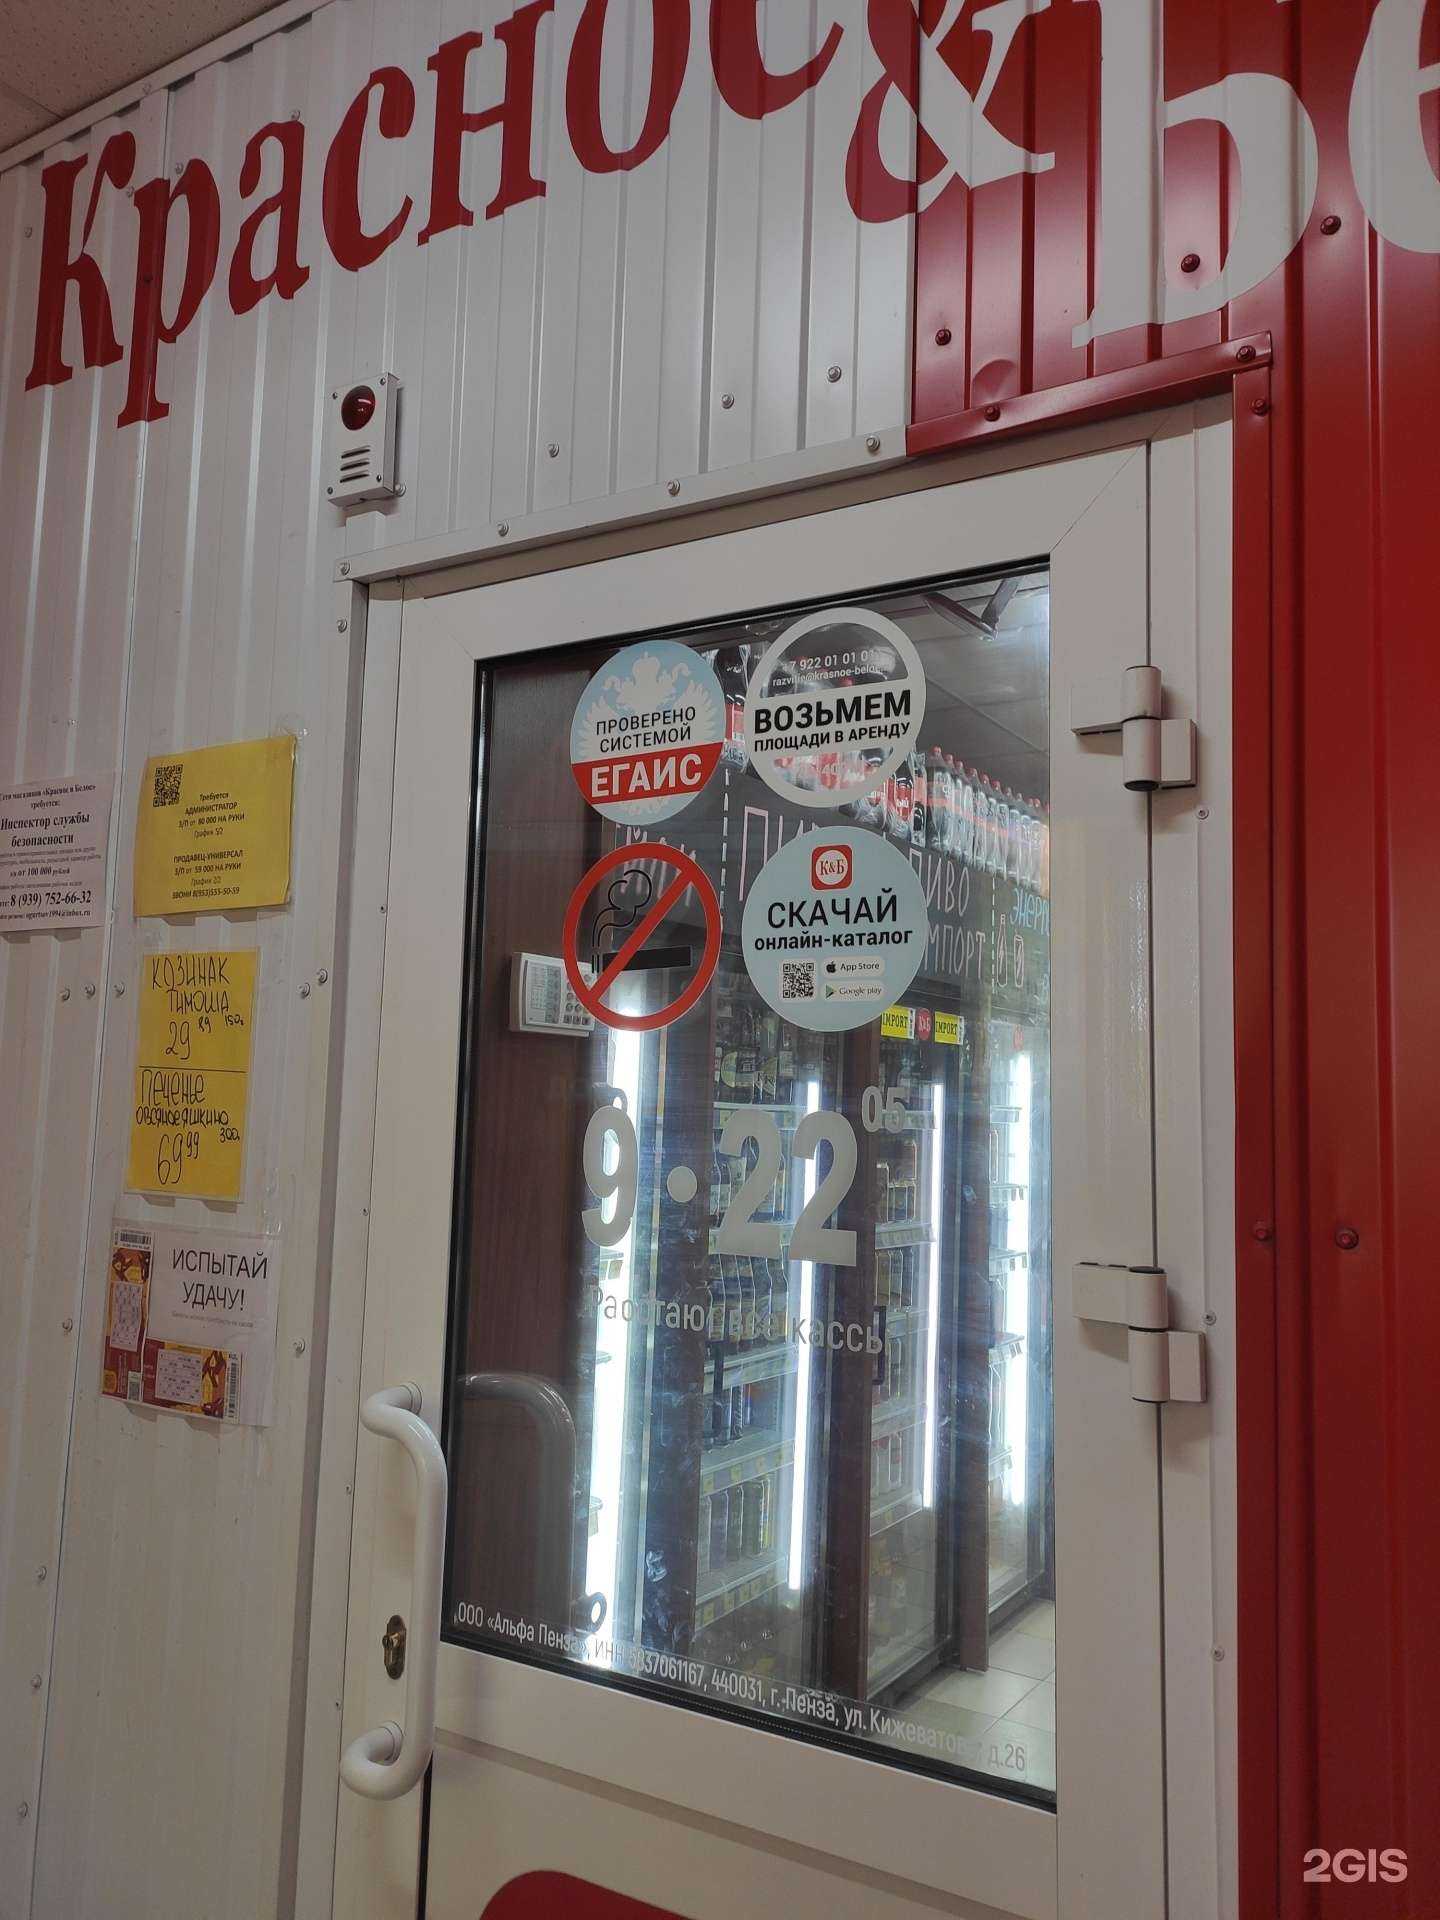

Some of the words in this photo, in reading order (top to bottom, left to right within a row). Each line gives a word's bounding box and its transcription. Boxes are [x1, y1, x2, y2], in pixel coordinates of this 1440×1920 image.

[799, 657, 821, 671] 922
[824, 654, 838, 667] 01
[842, 652, 856, 664] 01
[596, 706, 696, 736] ПРОВЕРЕНО
[754, 689, 911, 734] ВОЗЬМЕМ
[600, 722, 691, 753] СИСТЕМОЙ
[754, 731, 830, 752] ПЛОЩАДИ
[835, 731, 844, 743] В
[848, 722, 910, 742] АРЕНДУ
[591, 753, 702, 798] ЕГАИС
[200, 792, 229, 801] Требуется
[185, 801, 238, 816] АДМИНИСТРАТОР
[217, 815, 227, 823] НА
[228, 813, 245, 823] РУКИ
[1, 816, 50, 830] Инспектор
[53, 812, 90, 829] службы
[11, 834, 74, 847] безопасности
[174, 850, 243, 863] ПРОДАВЕЦ-УНИВЕРСАЛ
[214, 864, 224, 872] НА
[225, 863, 242, 871] РУКИ
[820, 859, 845, 876] К&Б
[27, 867, 39, 876] 100
[40, 866, 52, 875] 000
[10, 894, 17, 907] 8
[18, 893, 42, 909] (939)
[45, 890, 92, 905] 752-66-32
[768, 888, 898, 929] СКАЧАЙ
[754, 930, 913, 951] онлайн-каталог
[924, 922, 986, 981] МПОРТ
[840, 963, 857, 972] App
[858, 961, 880, 970] Store
[839, 986, 866, 996] Google
[867, 985, 882, 995] play
[882, 1012, 909, 1029] IMPORT
[935, 1020, 958, 1035] IMPORT
[165, 1020, 191, 1060] 29
[158, 1133, 184, 1185] 69
[186, 1131, 200, 1160] 99
[718, 1108, 858, 1267] 22
[861, 1085, 911, 1134] 05
[172, 1248, 268, 1279] ИСПЫТАЙ
[183, 1281, 245, 1311] УДАЧУ!
[457, 1601, 484, 1629] ООО
[487, 1611, 535, 1645] «Альфа
[711, 1668, 767, 1705] 440031,
[786, 1687, 840, 1726] Пенза,
[843, 1708, 867, 1731] ул.
[987, 1744, 1026, 1772] д.26
